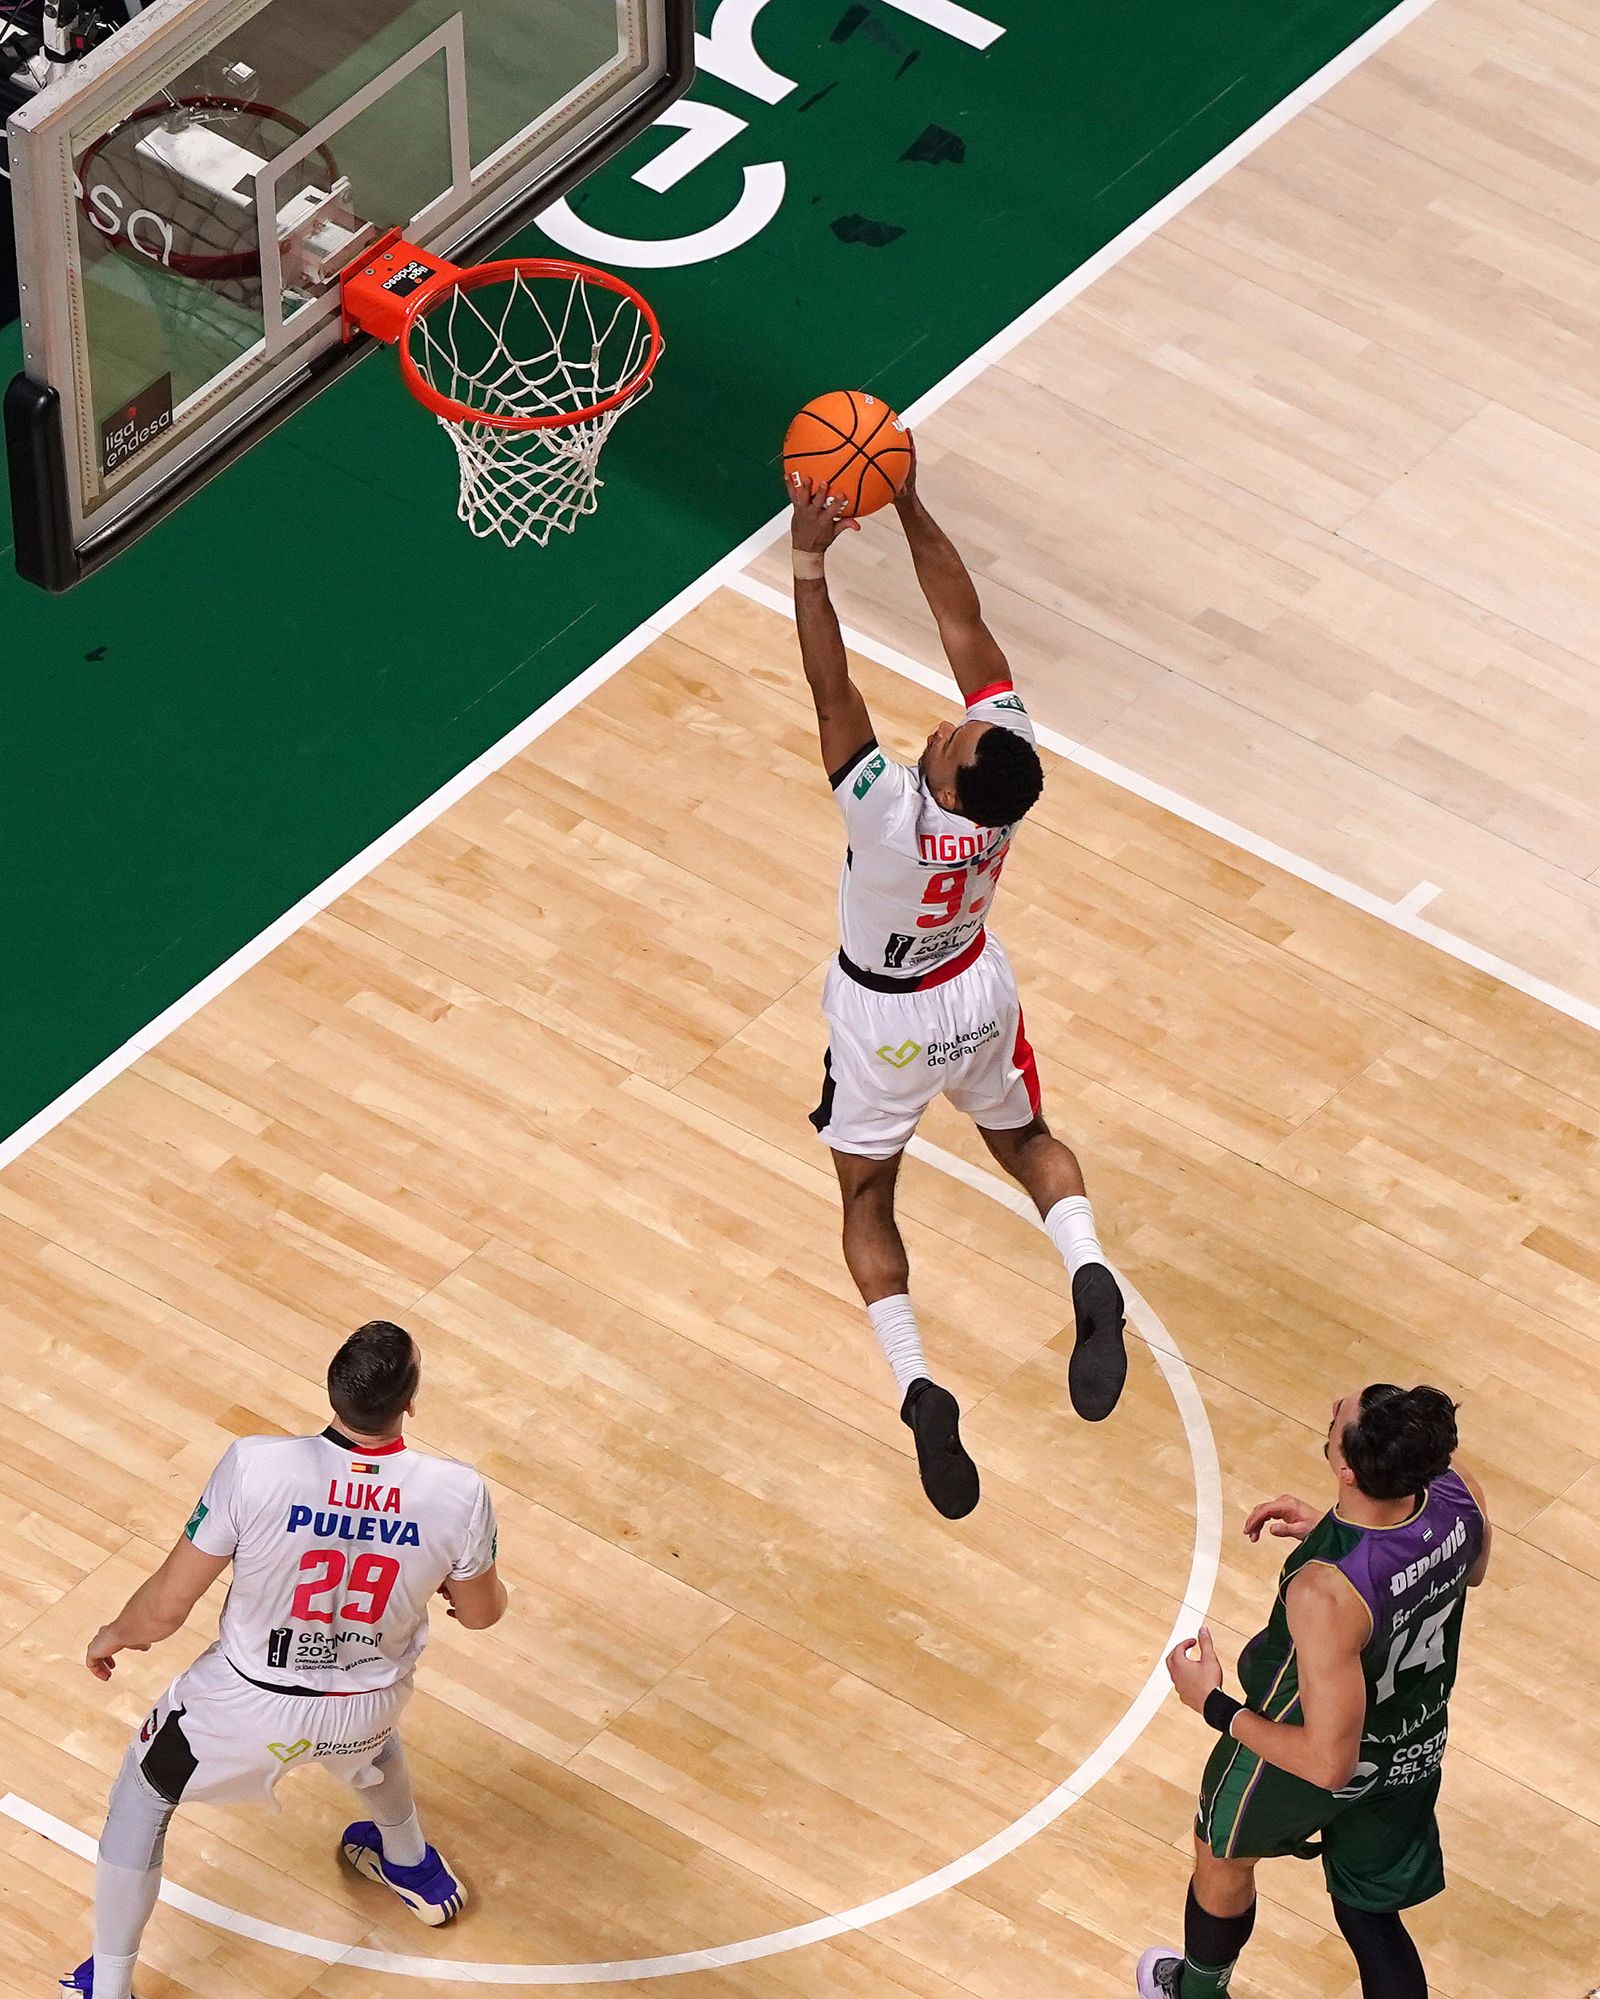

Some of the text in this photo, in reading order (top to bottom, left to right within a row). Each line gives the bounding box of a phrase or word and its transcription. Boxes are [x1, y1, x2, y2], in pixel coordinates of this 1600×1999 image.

[382, 261, 418, 290] endesa
[105, 420, 135, 452] liga
[106, 410, 170, 468] endesa
[927, 1020, 997, 1056] Diputación
[927, 1055, 946, 1067] de
[327, 1479, 401, 1514] LUKA
[286, 1504, 421, 1547] PULEVA
[290, 1549, 400, 1625] 29
[1375, 1597, 1458, 1705] 14
[1392, 1726, 1448, 1763] COSTA
[1388, 1761, 1422, 1778] DEL
